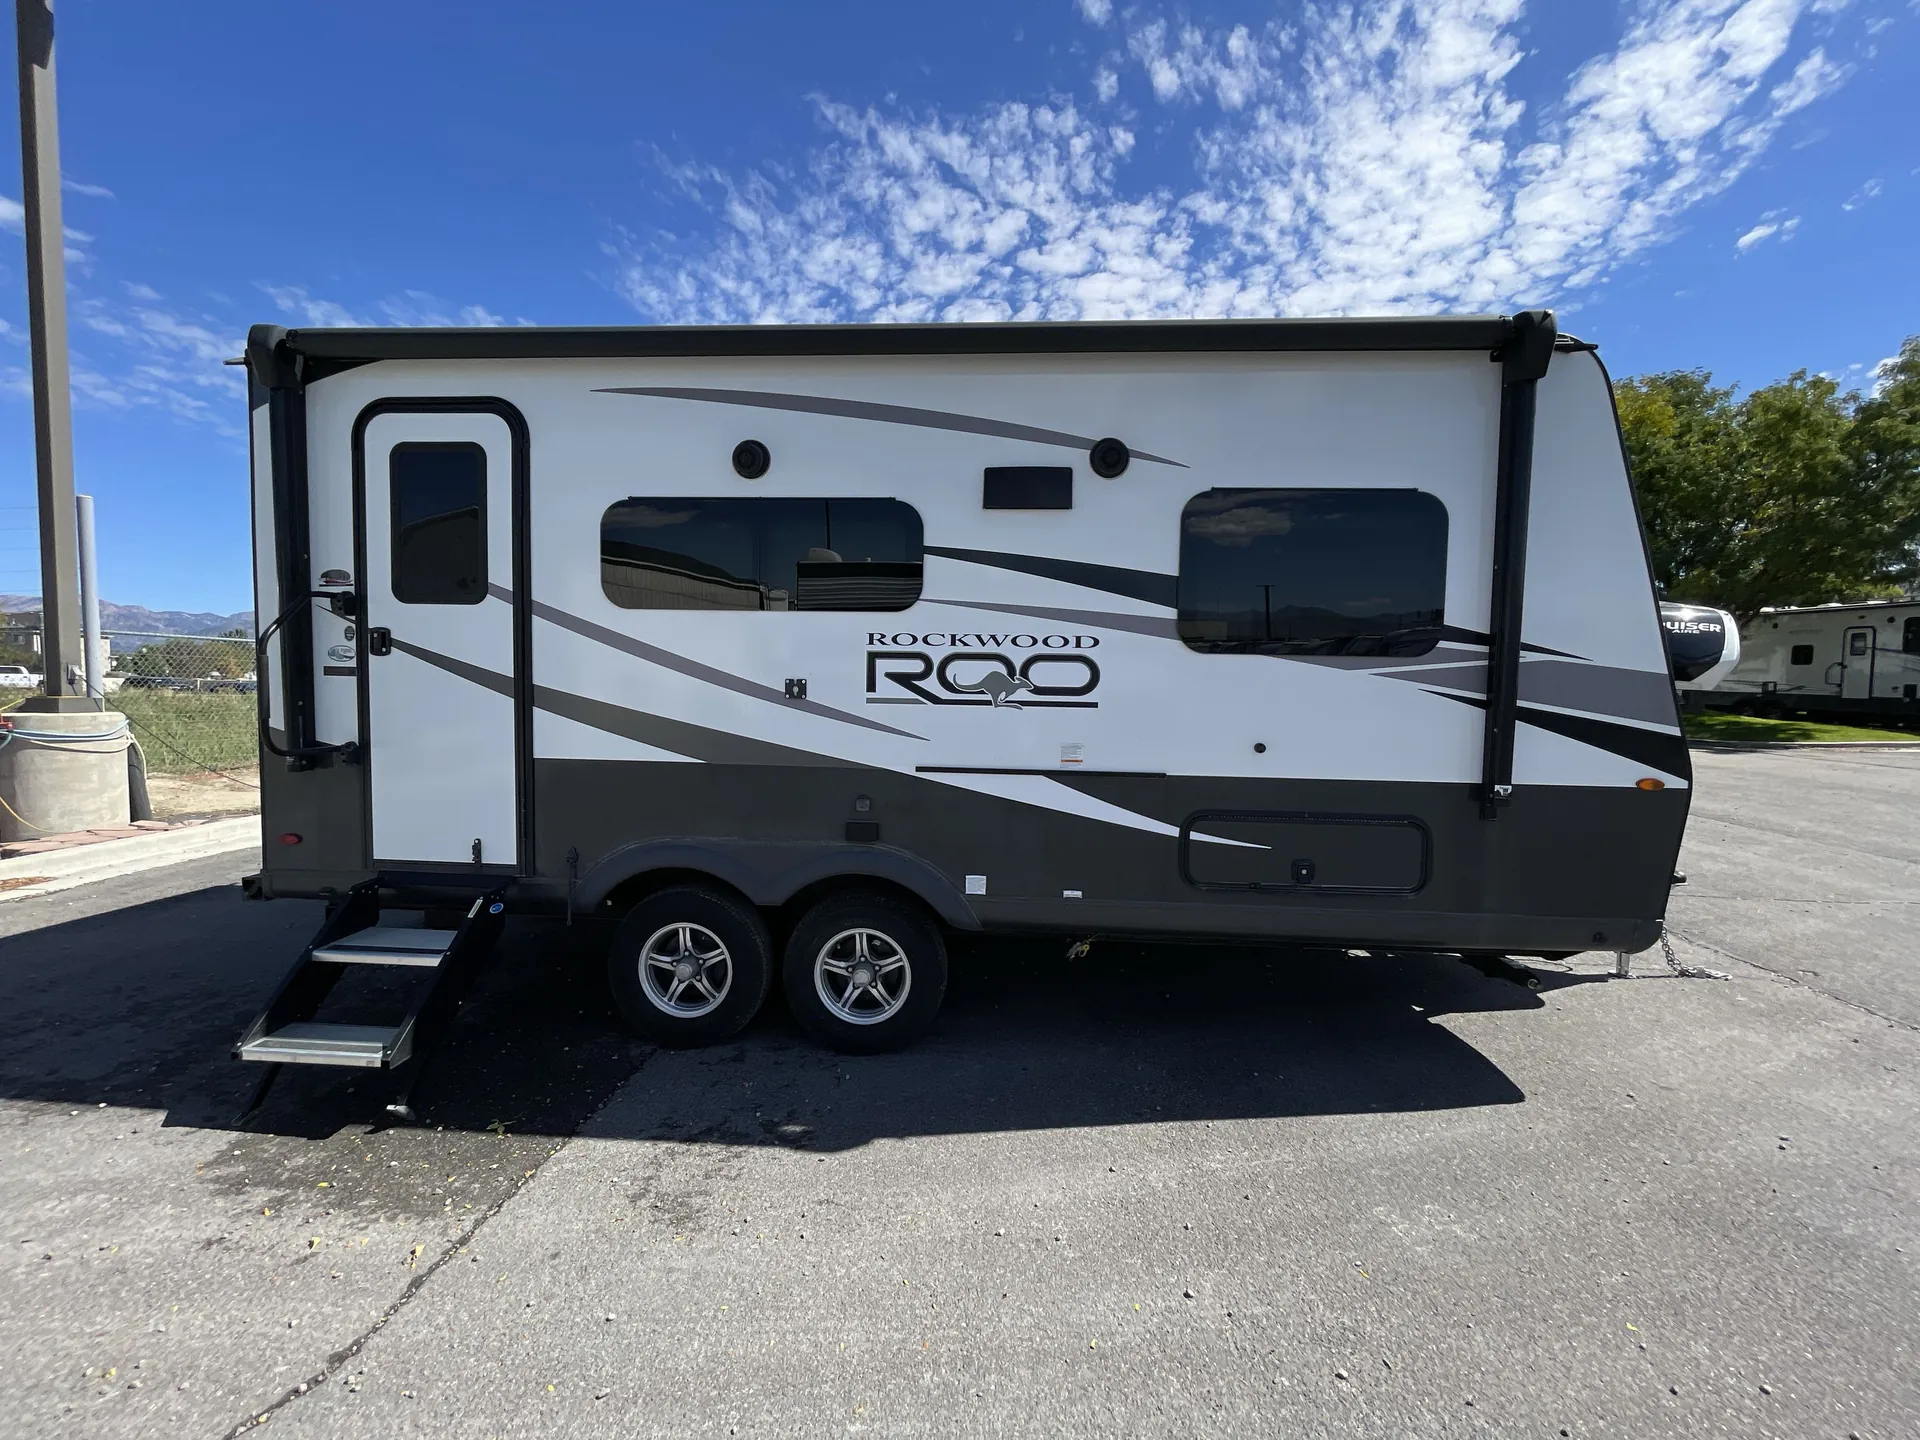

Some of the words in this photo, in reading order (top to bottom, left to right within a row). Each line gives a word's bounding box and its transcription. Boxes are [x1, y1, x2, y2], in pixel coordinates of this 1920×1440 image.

[1663, 621, 1722, 633] UISER
[865, 632, 1100, 649] ROCKWOOD
[865, 650, 1101, 706] ROO
